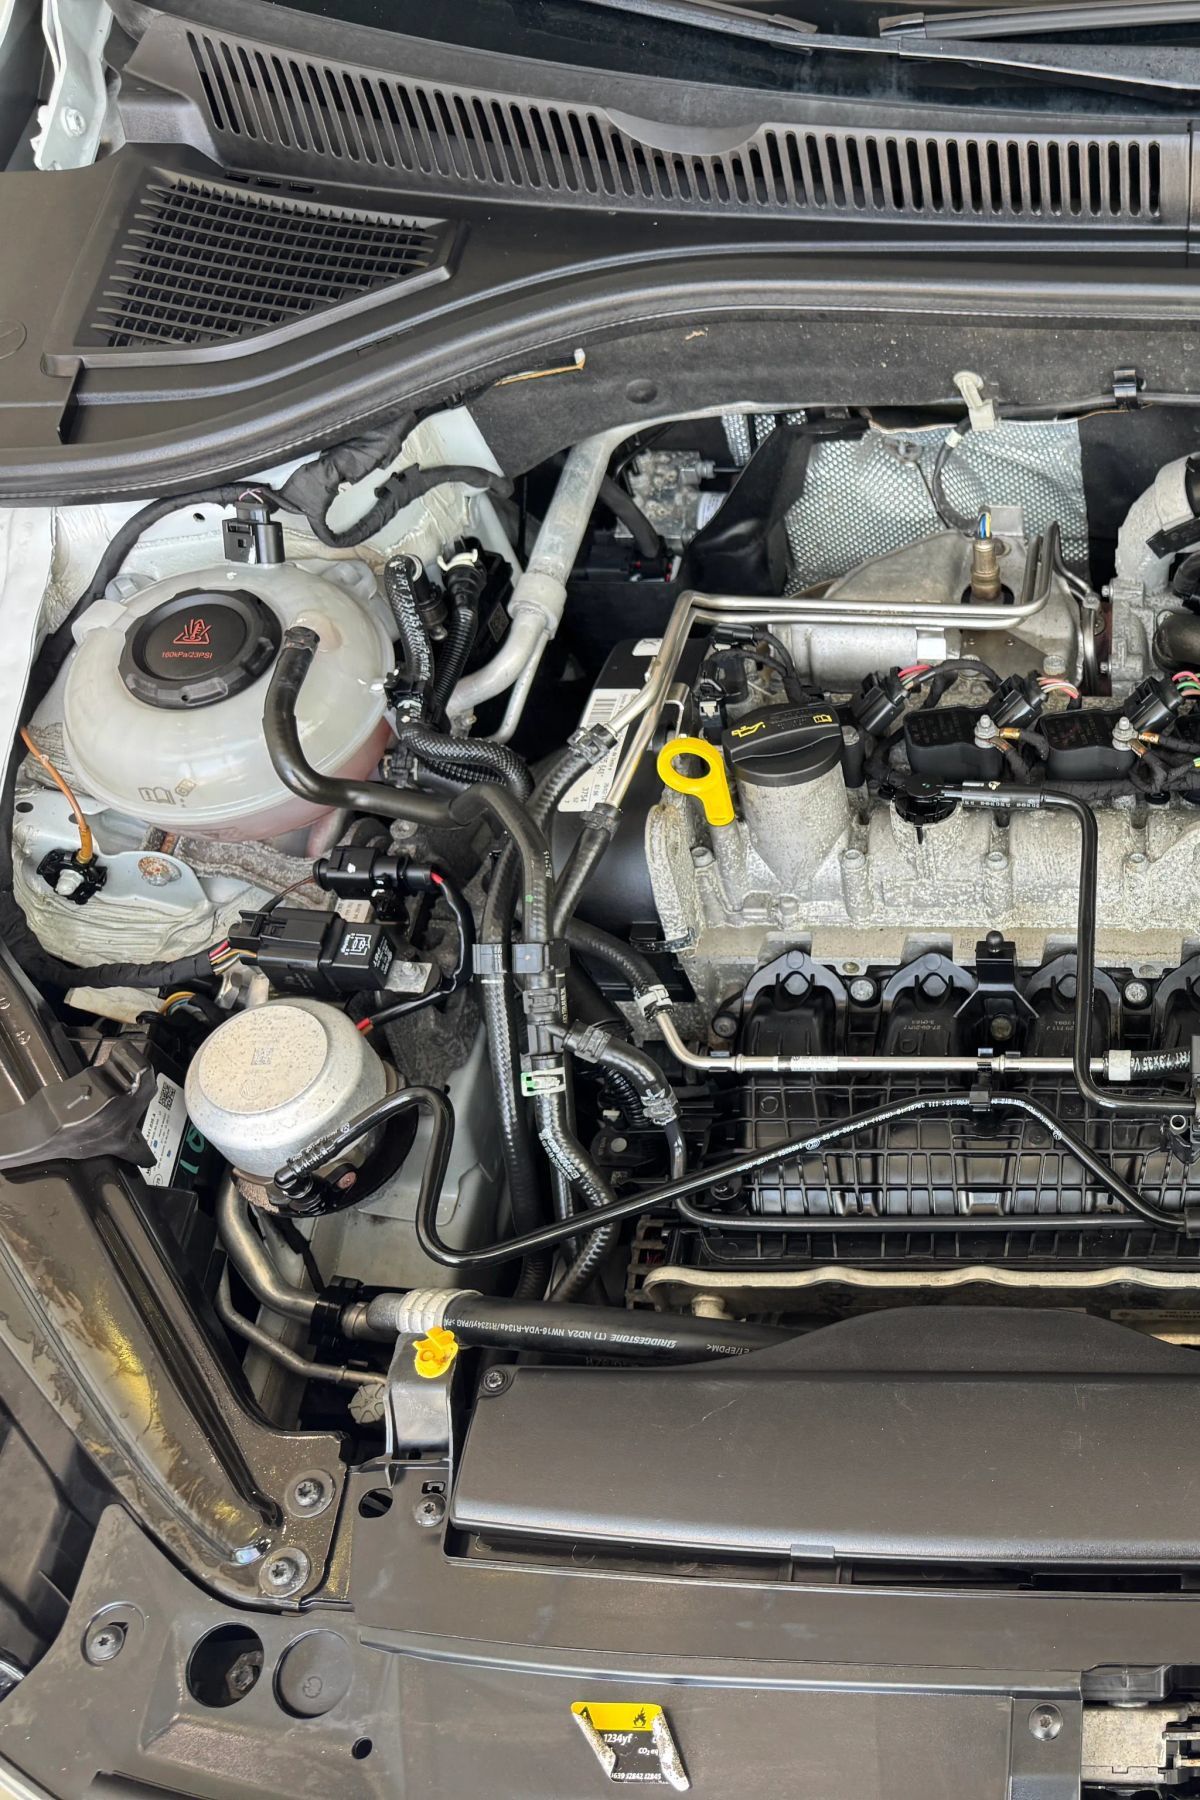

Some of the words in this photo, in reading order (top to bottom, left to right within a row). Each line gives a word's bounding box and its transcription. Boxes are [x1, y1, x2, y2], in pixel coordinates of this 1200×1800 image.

[162, 651, 213, 660] 160kPa/23PSI
[568, 1329, 592, 1340] ND2A
[594, 1332, 607, 1342] (T)
[609, 1334, 678, 1349] BRIDGESTONE
[603, 1733, 633, 1746] 1234yf
